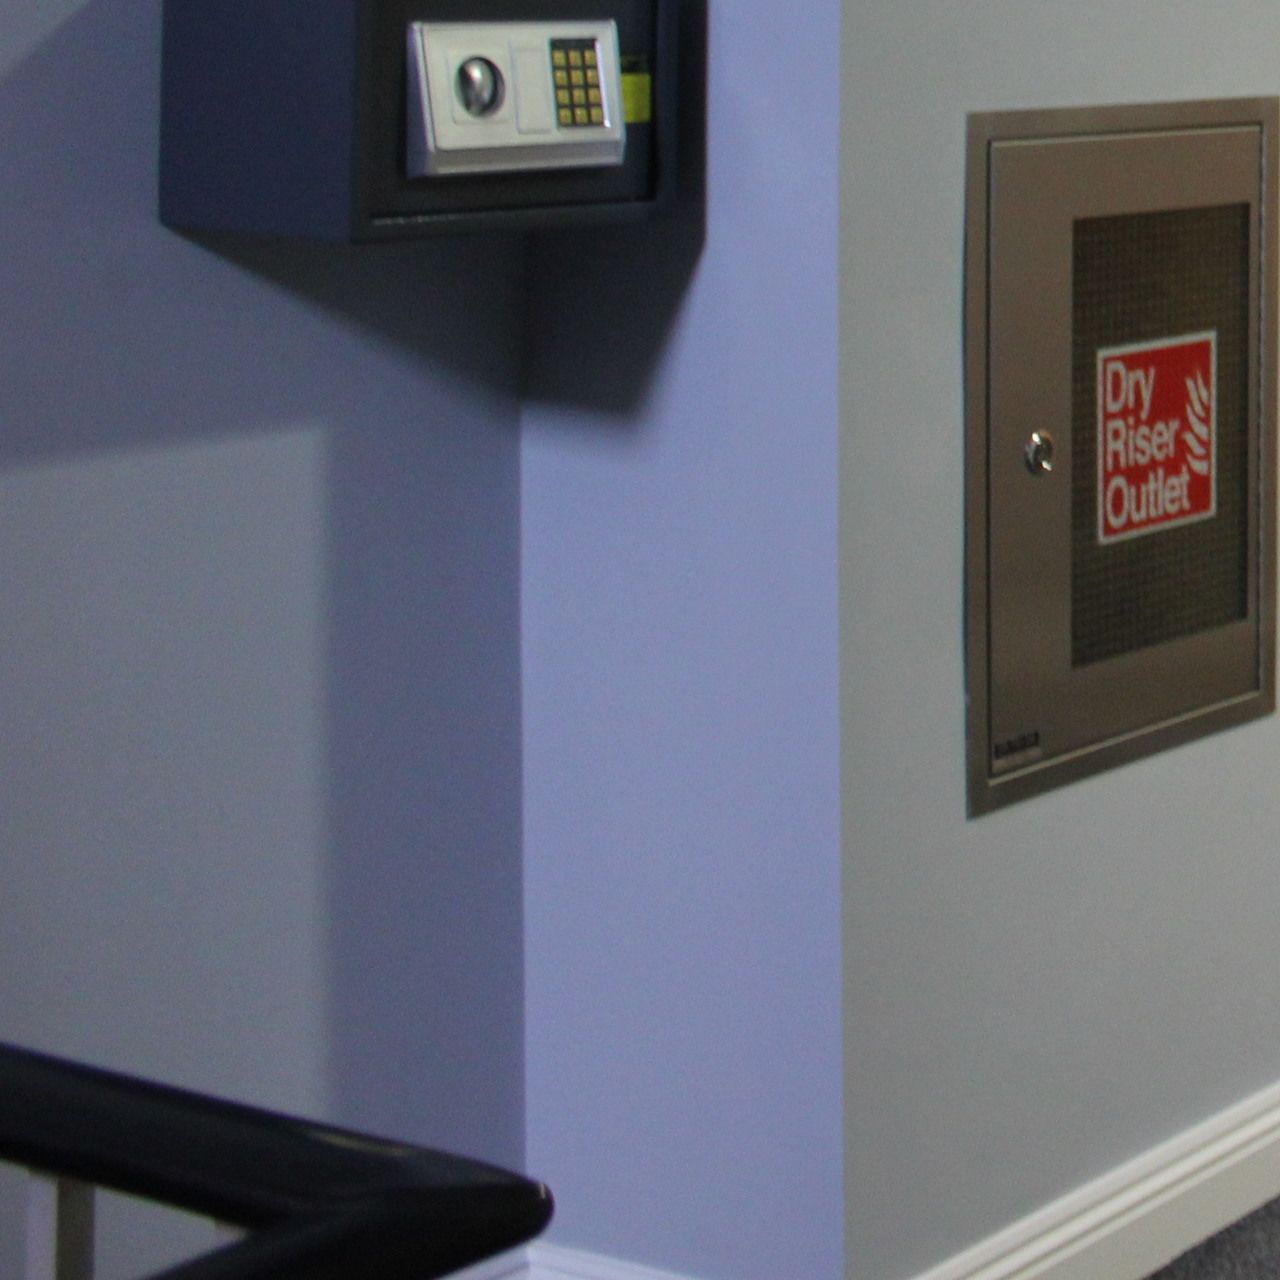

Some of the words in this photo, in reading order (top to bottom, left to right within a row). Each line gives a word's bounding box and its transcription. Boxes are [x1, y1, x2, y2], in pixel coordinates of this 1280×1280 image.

[1106, 360, 1155, 420] Dry
[1106, 416, 1180, 471] Riser
[1106, 465, 1190, 528] Outlet
